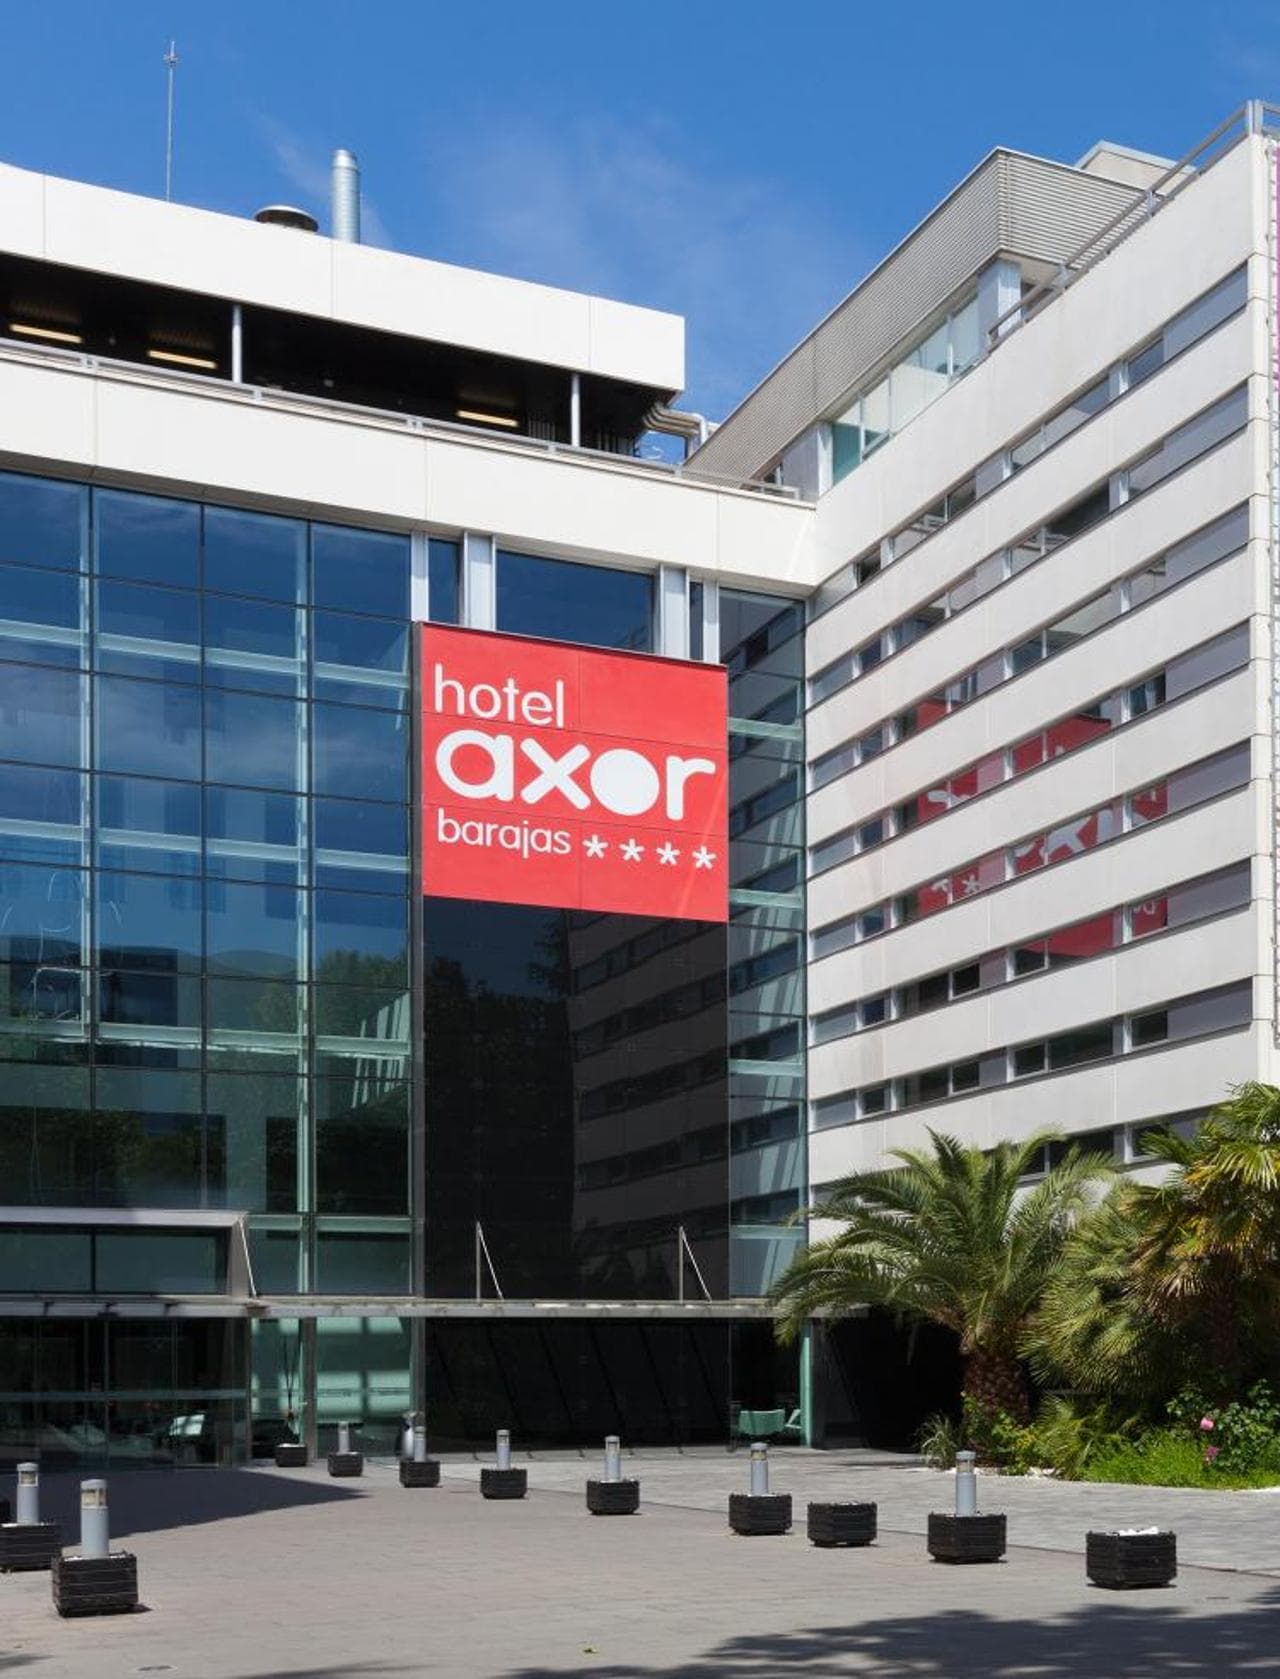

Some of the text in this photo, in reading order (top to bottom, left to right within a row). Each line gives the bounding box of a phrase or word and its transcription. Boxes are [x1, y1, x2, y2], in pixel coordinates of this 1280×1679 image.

[434, 663, 564, 728] hotel
[435, 729, 716, 821] axor
[437, 807, 572, 859] barajas
